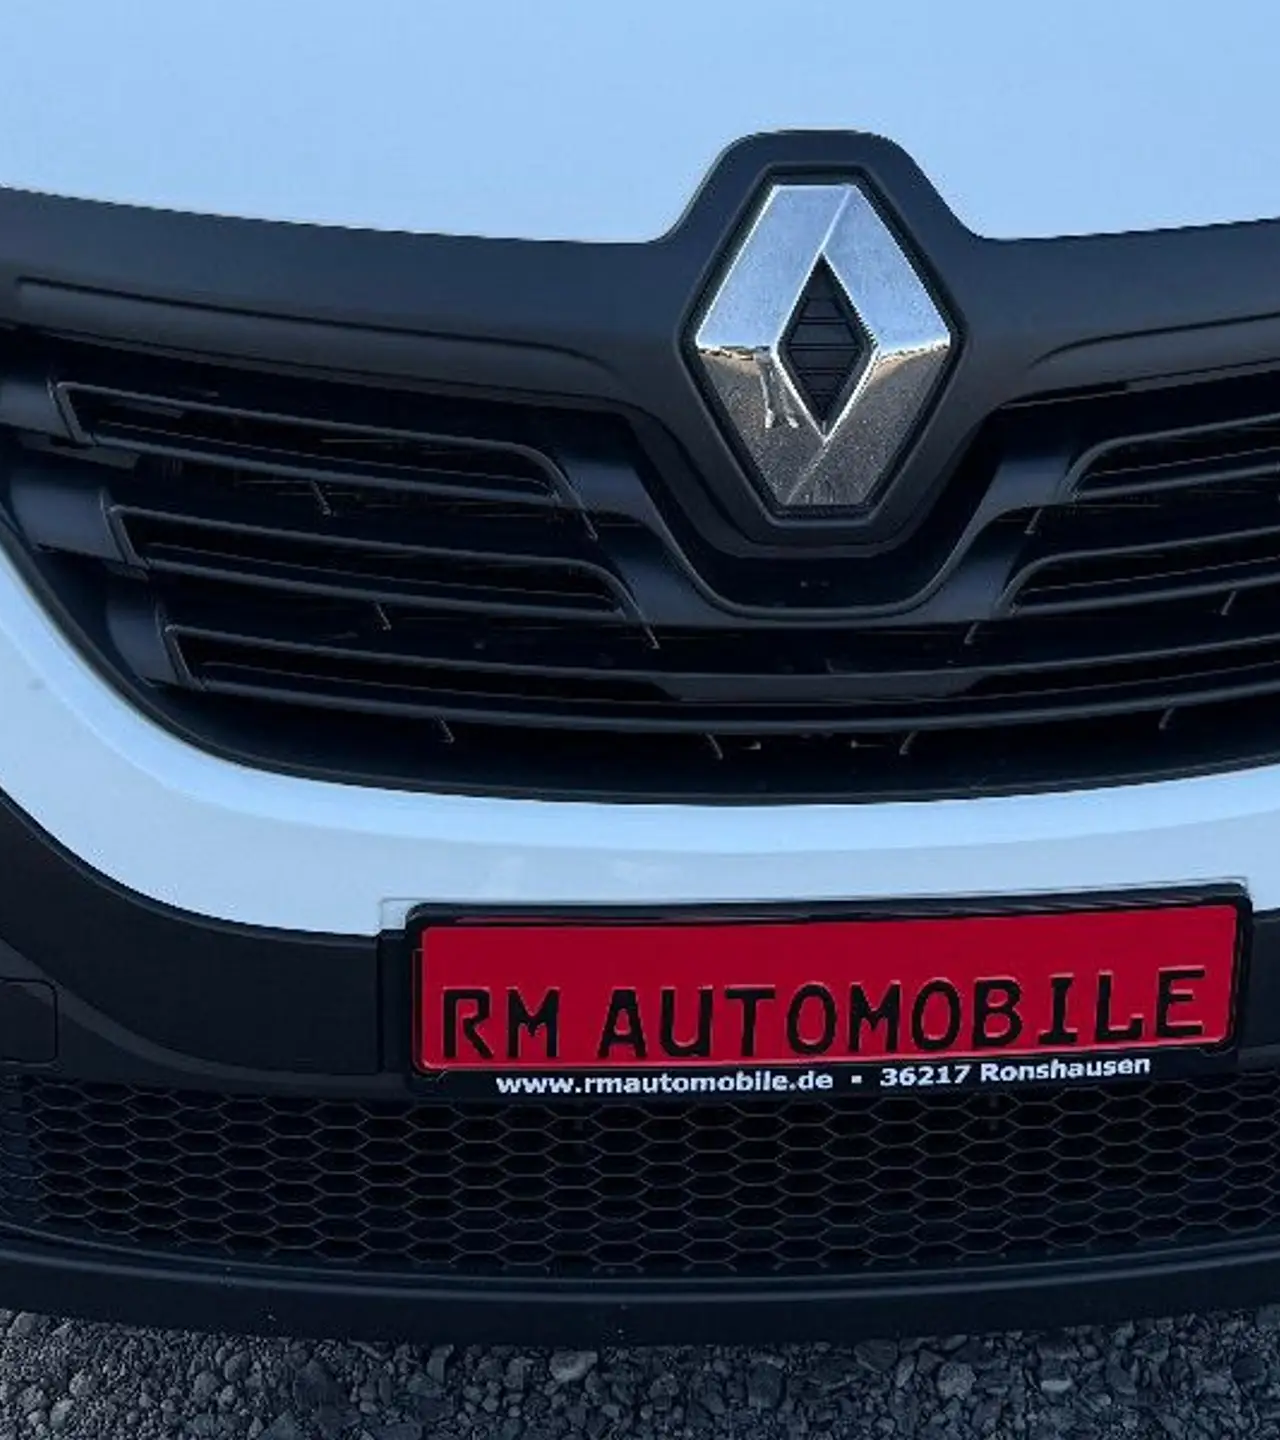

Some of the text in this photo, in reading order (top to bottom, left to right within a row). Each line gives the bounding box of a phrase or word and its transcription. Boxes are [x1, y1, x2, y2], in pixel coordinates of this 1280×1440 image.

[442, 965, 1207, 1059] RM AUTOMOBILE
[495, 1057, 1151, 1094] www.rmautomobile.de 36217 Ronshausen
